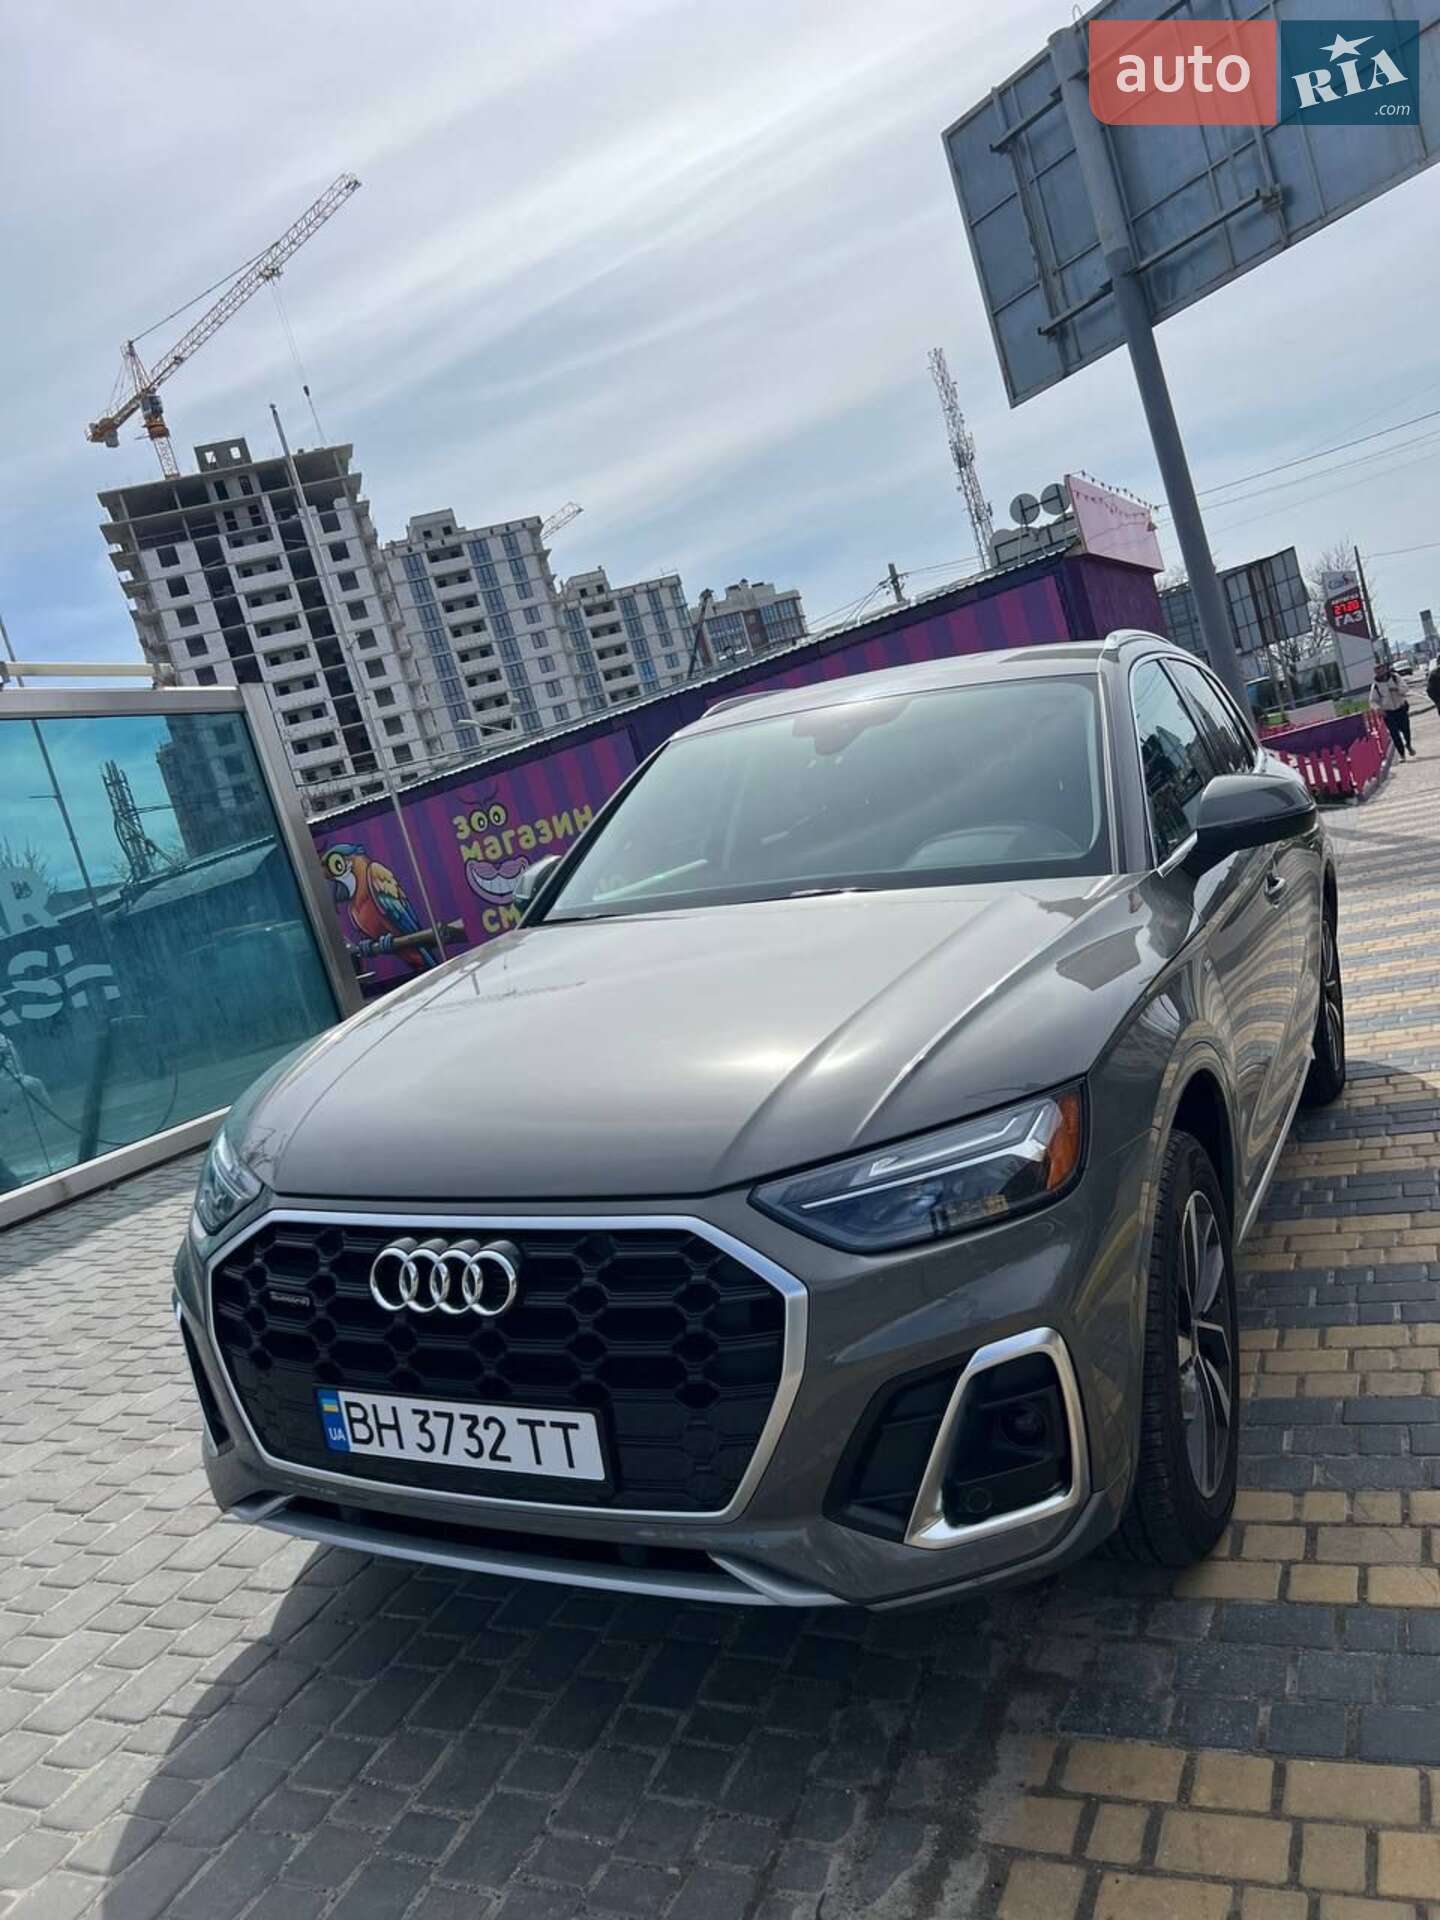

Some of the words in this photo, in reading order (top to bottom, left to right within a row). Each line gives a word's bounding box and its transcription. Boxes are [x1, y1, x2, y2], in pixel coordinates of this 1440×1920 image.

[1335, 610, 1363, 627] ГАЗ
[328, 1427, 346, 1441] UA
[344, 1400, 405, 1451] BH
[411, 1408, 512, 1464] 3732
[516, 1418, 579, 1470] TT
